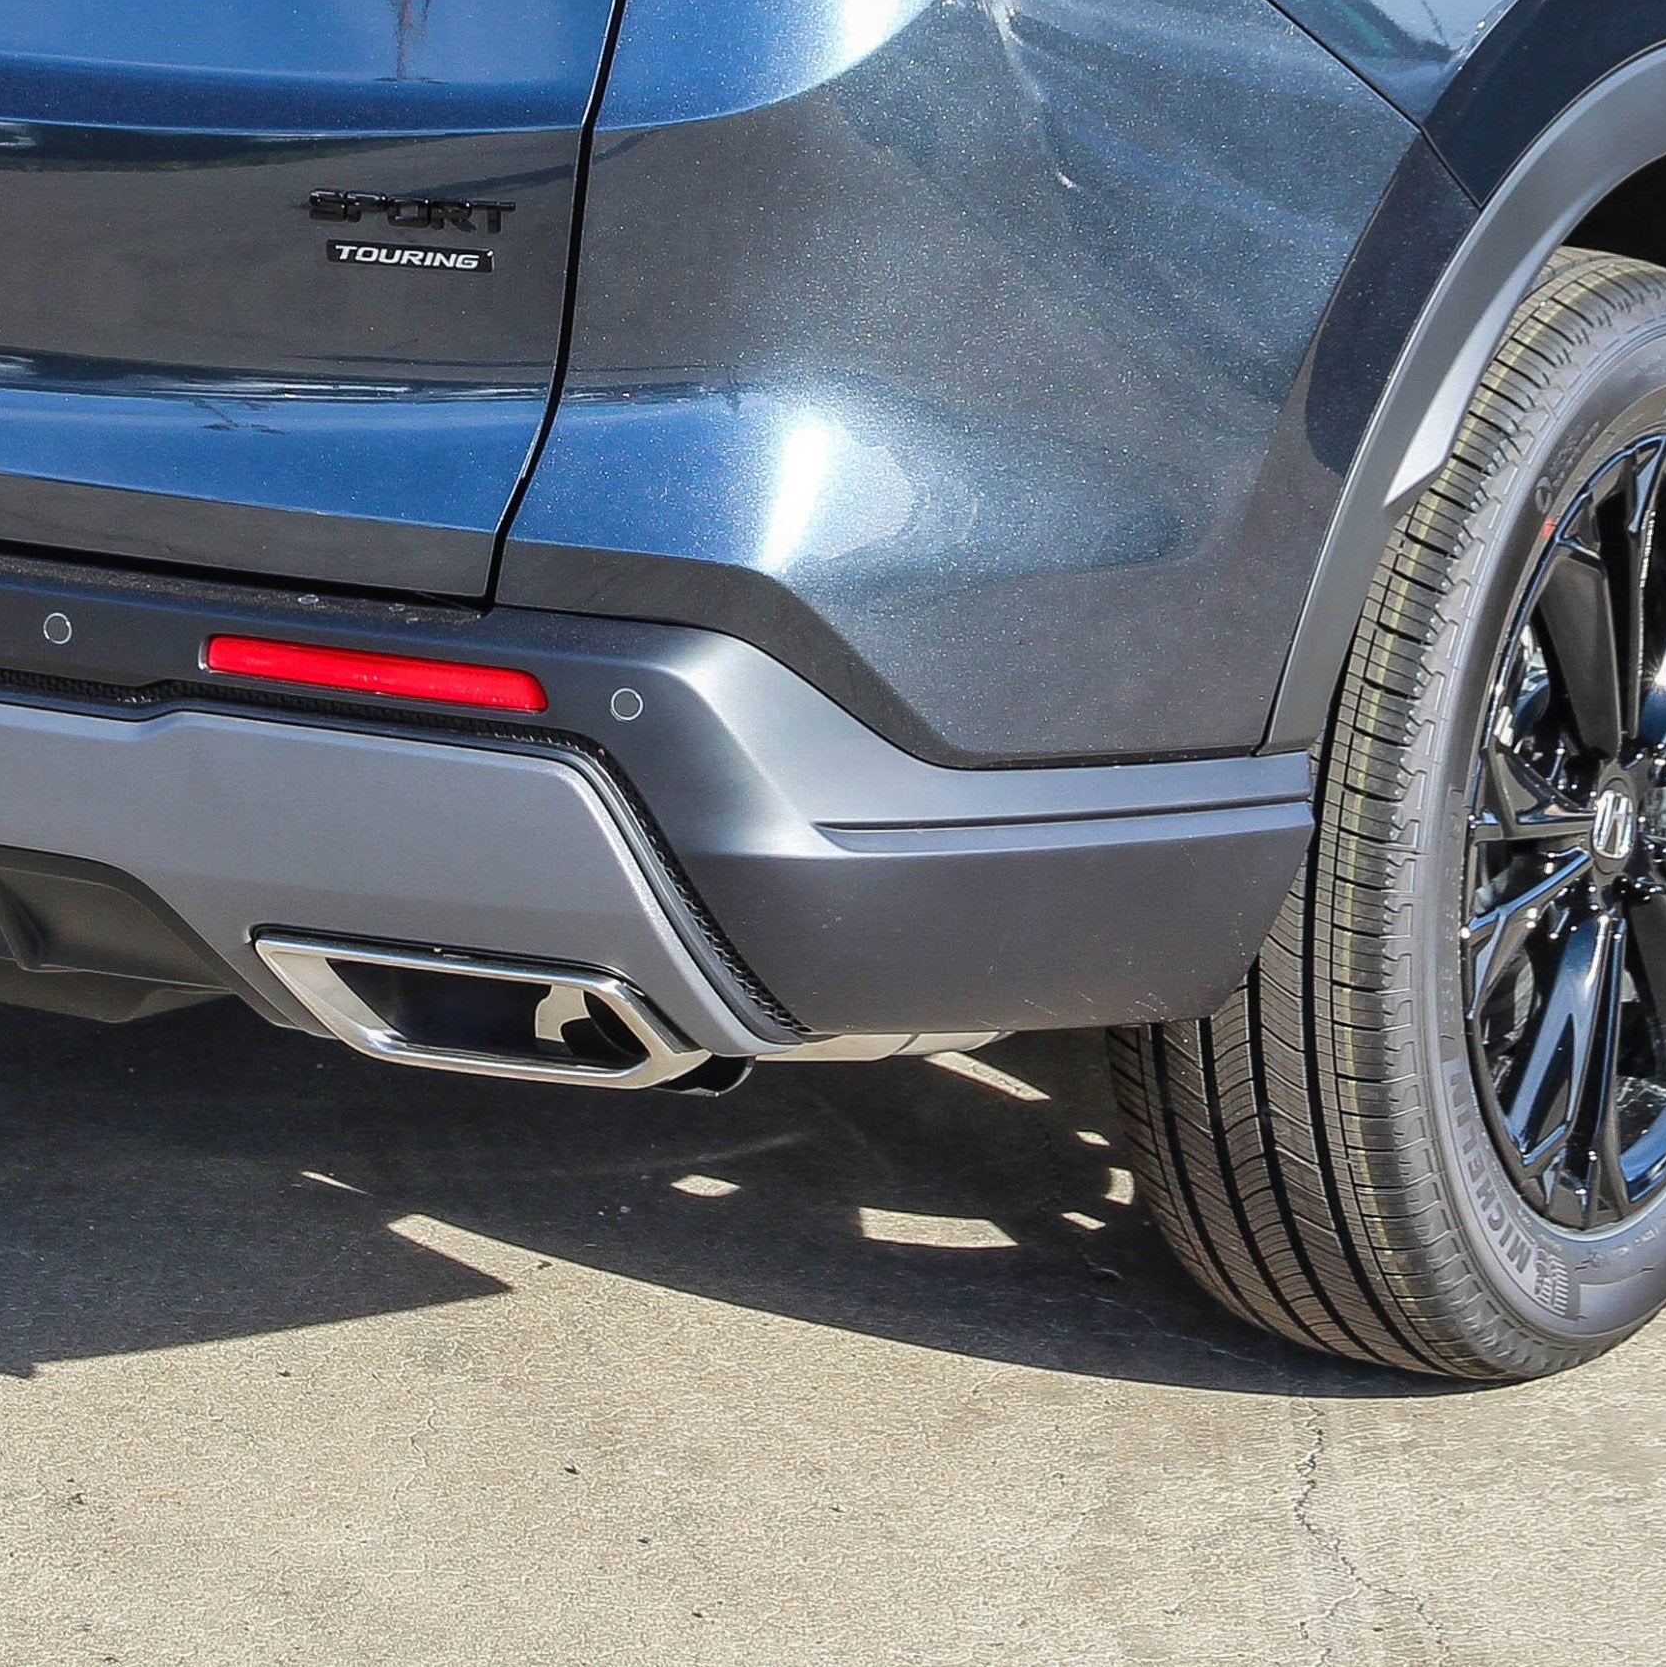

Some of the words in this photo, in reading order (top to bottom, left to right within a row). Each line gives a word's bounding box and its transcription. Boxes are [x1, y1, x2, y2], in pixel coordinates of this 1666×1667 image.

[309, 188, 516, 234] SPORT
[335, 244, 480, 270] TOURING
[1449, 1071, 1533, 1274] MICHELIN
